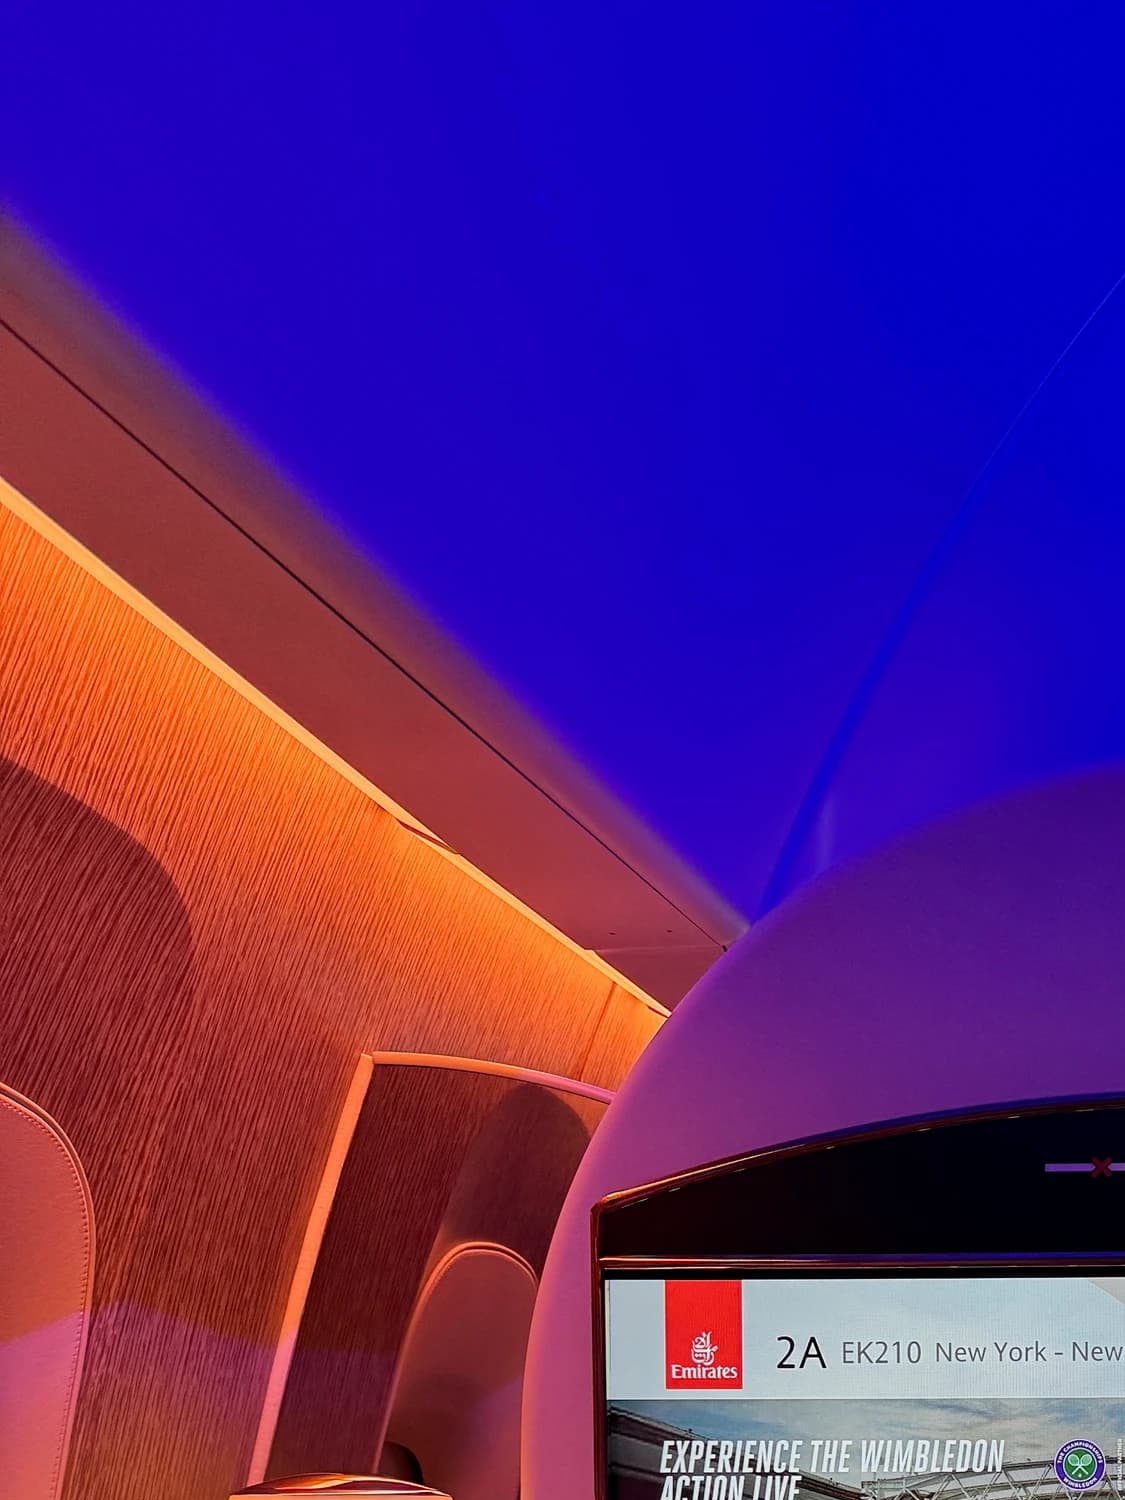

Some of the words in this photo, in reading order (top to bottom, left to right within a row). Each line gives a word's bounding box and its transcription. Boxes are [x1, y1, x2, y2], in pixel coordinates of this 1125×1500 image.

[776, 1335, 828, 1370] 2A
[842, 1340, 922, 1364] EK210
[935, 1341, 987, 1364] New
[993, 1340, 1048, 1363] York
[671, 1364, 738, 1380] Emirates
[659, 1439, 803, 1473] EXPERIENCE
[810, 1440, 853, 1473] THE
[860, 1438, 1006, 1473] WIMBLEDON
